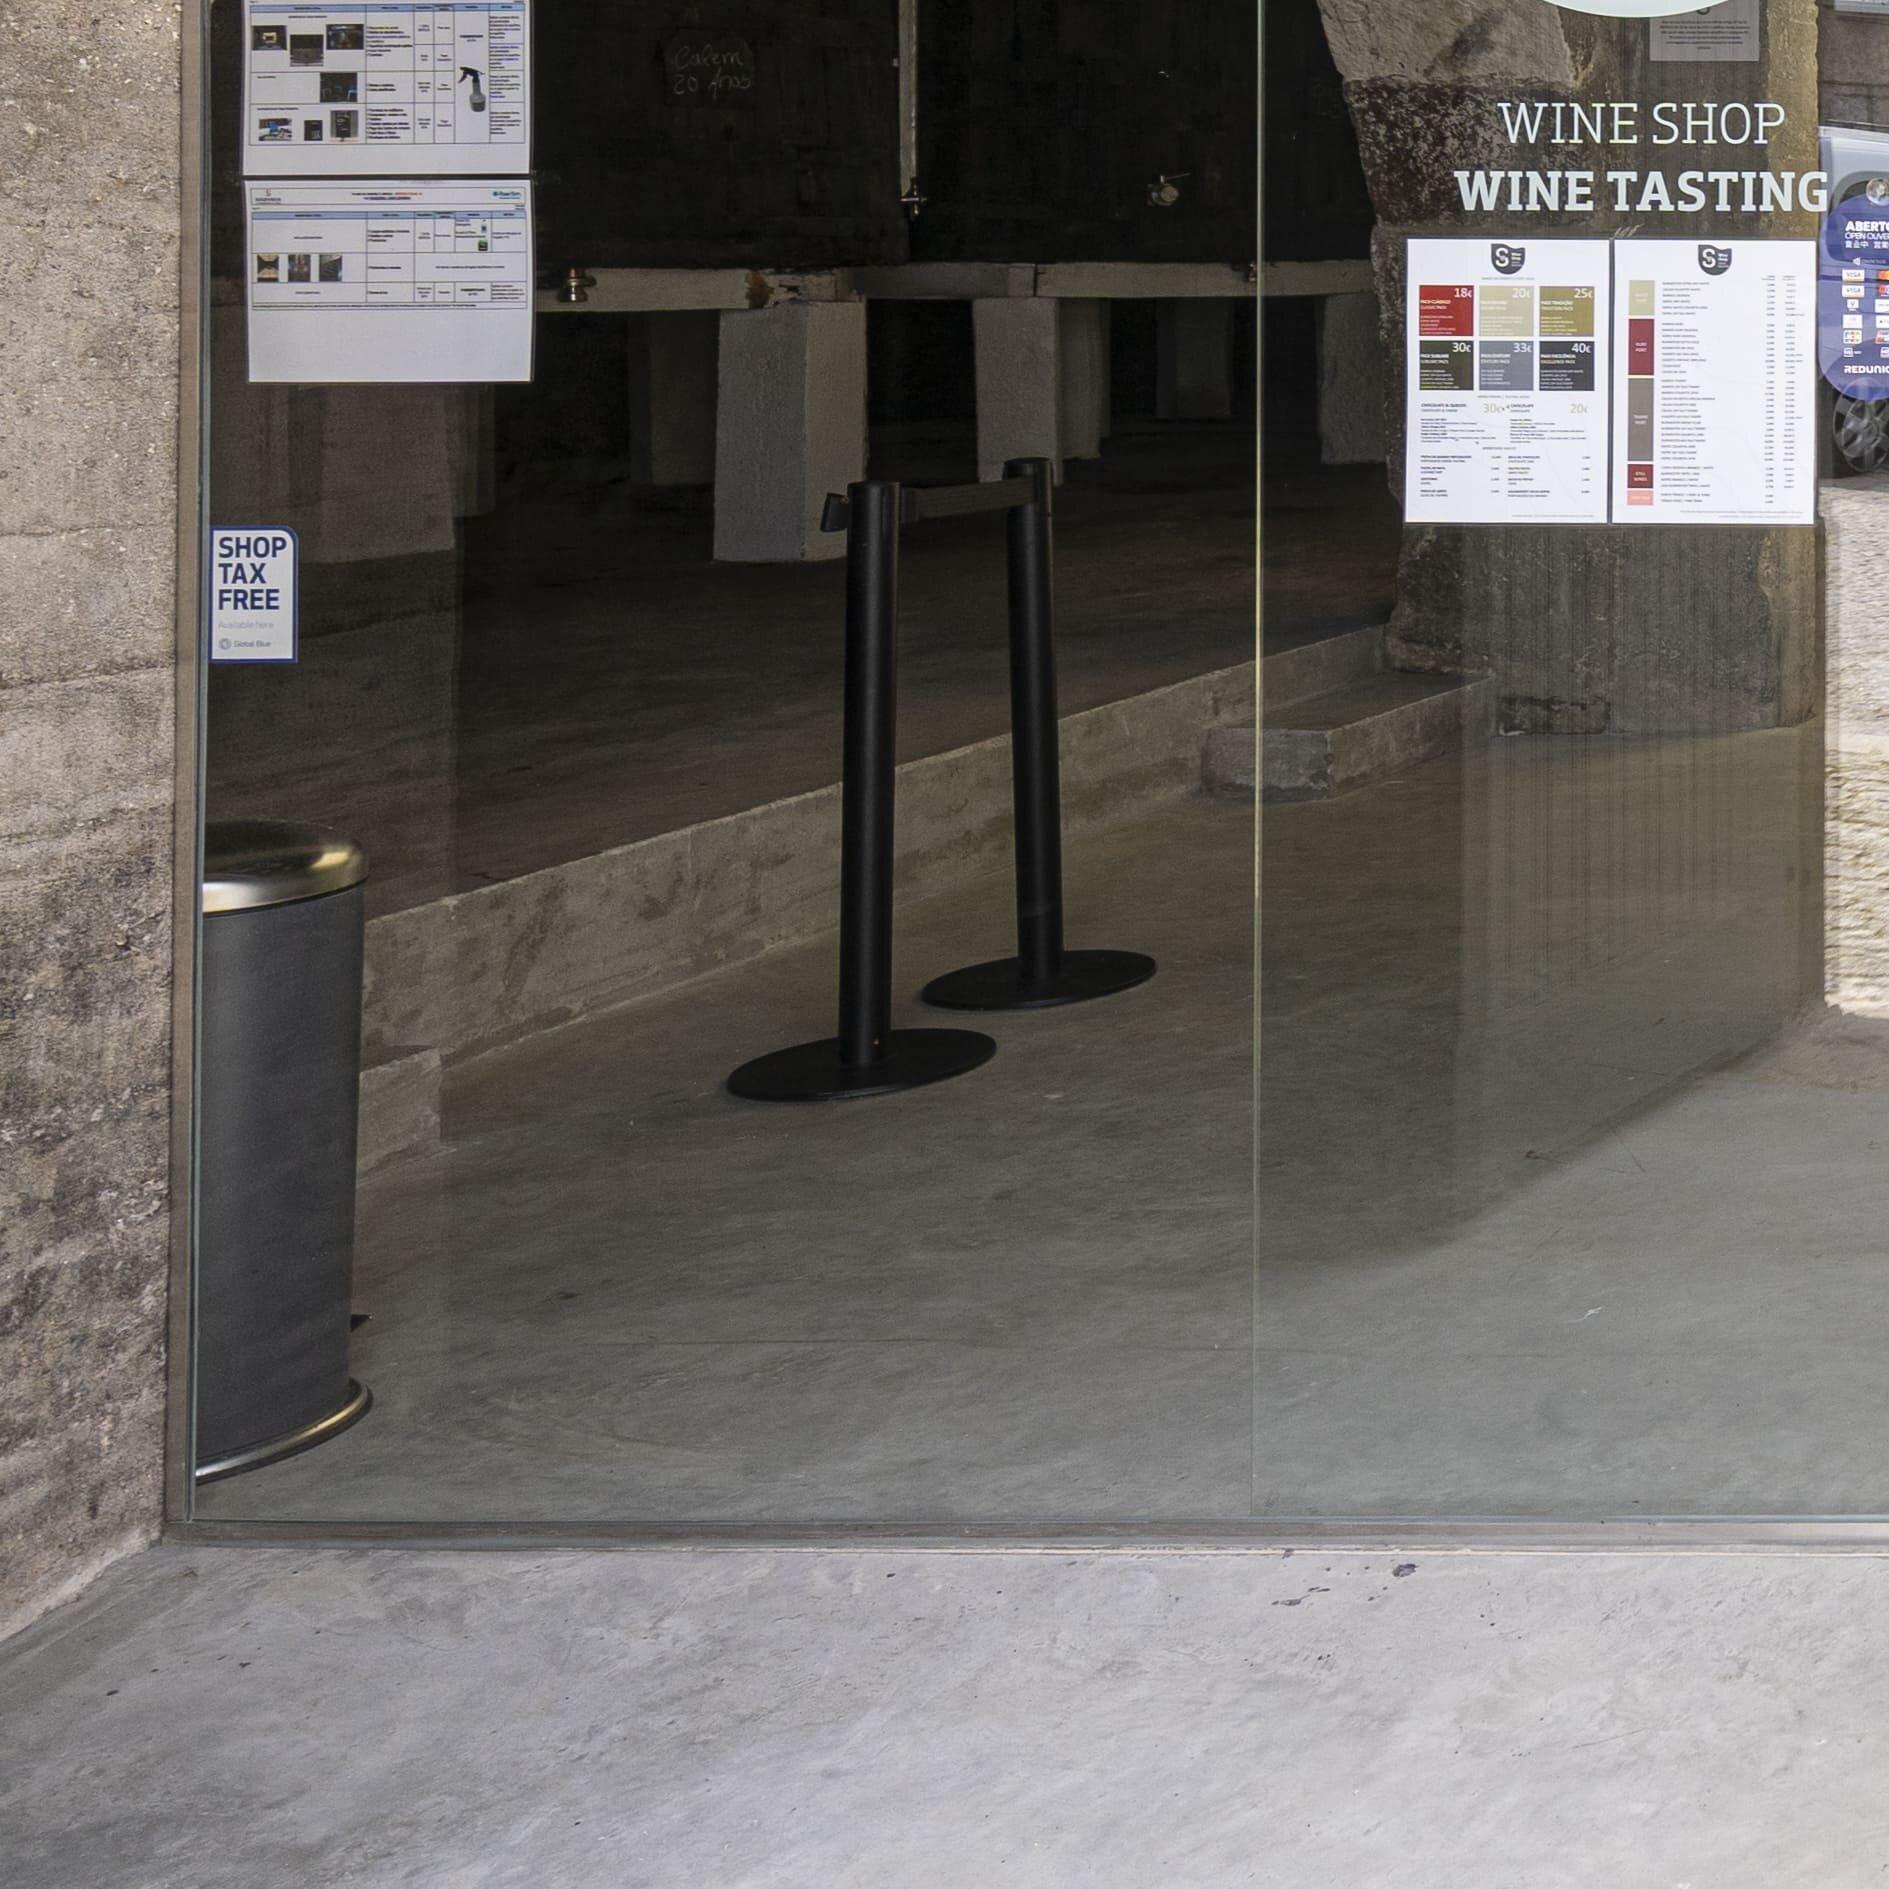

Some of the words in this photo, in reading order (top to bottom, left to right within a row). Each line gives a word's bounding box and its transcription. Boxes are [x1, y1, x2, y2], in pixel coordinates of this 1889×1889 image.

[1497, 102, 1638, 145] WINE
[1652, 102, 1787, 145] SHOP
[1454, 170, 1595, 213] WINE
[1607, 170, 1828, 213] TASTING
[1844, 232, 1866, 240] OPEN
[1453, 287, 1473, 299] 18€
[1574, 287, 1593, 299] 25€
[1451, 342, 1471, 353] 30€
[1513, 342, 1532, 353] 33€
[1571, 342, 1591, 354] 40€
[218, 536, 287, 559] SHOP
[218, 562, 267, 584] TAX
[218, 588, 280, 611] FREE
[233, 638, 255, 648] Global
[255, 639, 272, 648] Blue
